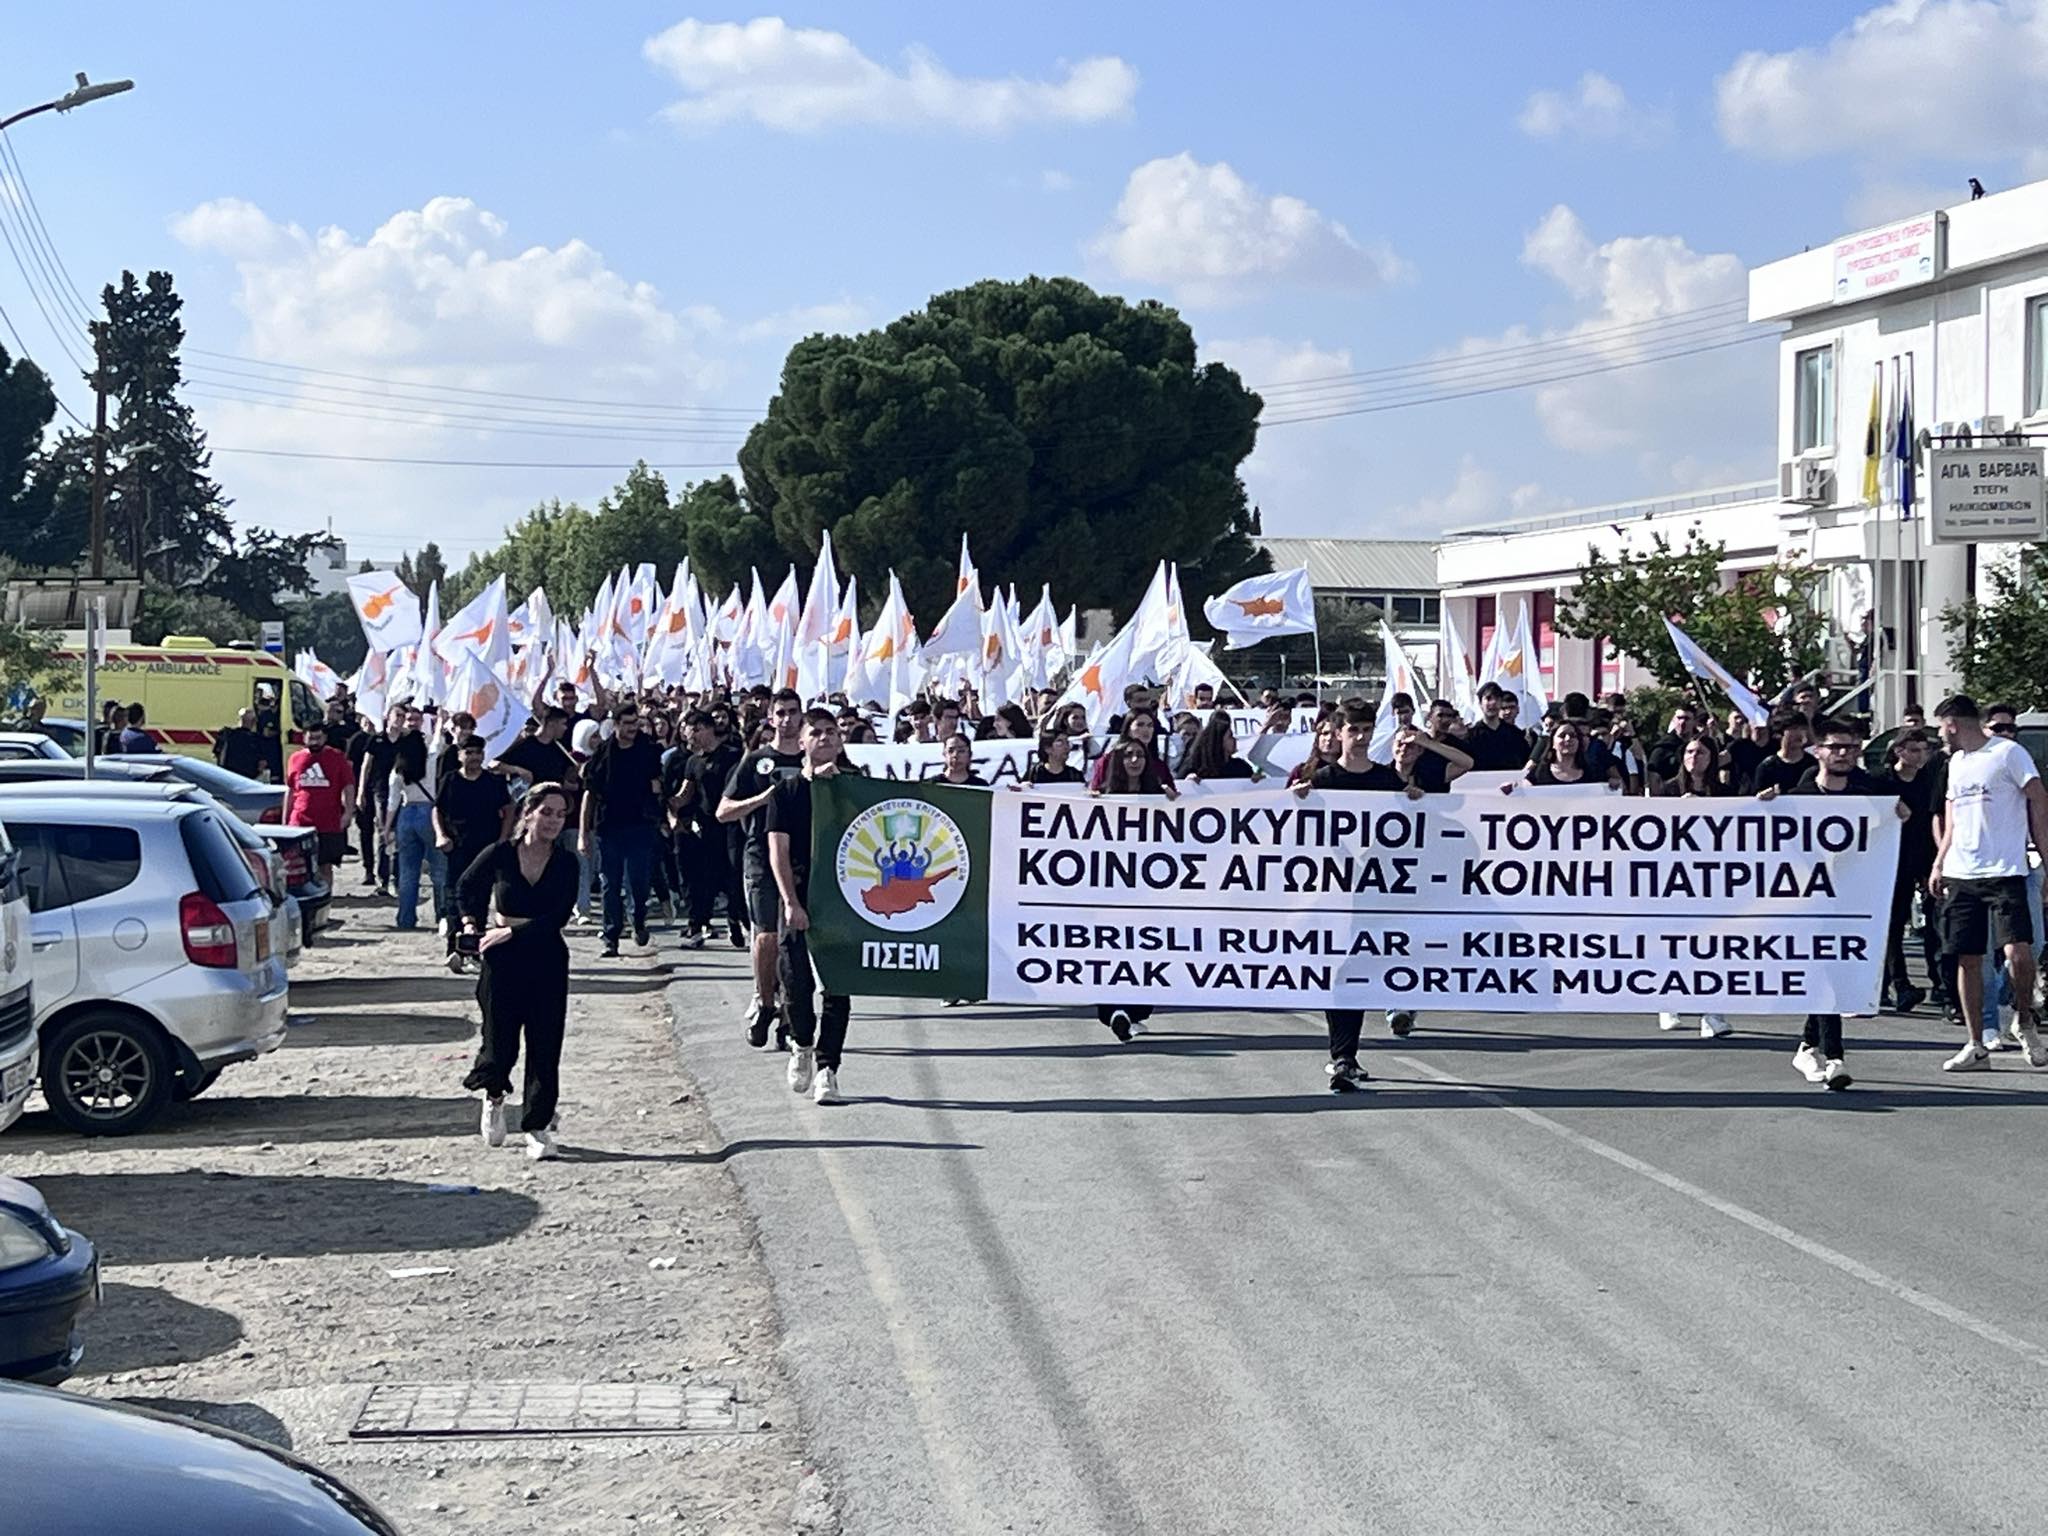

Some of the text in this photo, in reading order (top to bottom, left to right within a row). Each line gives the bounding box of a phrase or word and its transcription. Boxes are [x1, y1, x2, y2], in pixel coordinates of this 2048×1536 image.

[1941, 462, 2039, 478] ΑΓΙΑ ΒΑΡΒΑΡΑ
[145, 662, 222, 675] AMBULANCE
[1020, 801, 1426, 849] ΕΛΛΗΝΟΚΥΠΡΙΟΙ
[1479, 813, 1869, 853] ΤΟΥΡΚΟΚΥΠΡΙΟΙ
[1018, 848, 1208, 891] ΚΟΙΝΟΣ
[1219, 854, 1419, 895] ΑΓΩΝΑΣ
[1461, 858, 1613, 898] ΚΟΙΝΗ
[1629, 860, 1837, 898] ΠΑΤΡΙΔΑ
[861, 941, 940, 971] ΠΣΕΜ
[1017, 922, 1203, 952] KIBRISLI
[1218, 927, 1411, 957] RUMLAR
[1462, 931, 1646, 960] KIBRISLI
[1660, 934, 1869, 962] TURKLER
[1016, 957, 1171, 987] ORTAK
[1184, 962, 1332, 991] VATAN
[1383, 966, 1539, 995] ORTAK
[1552, 968, 1807, 996] MUCADELE
